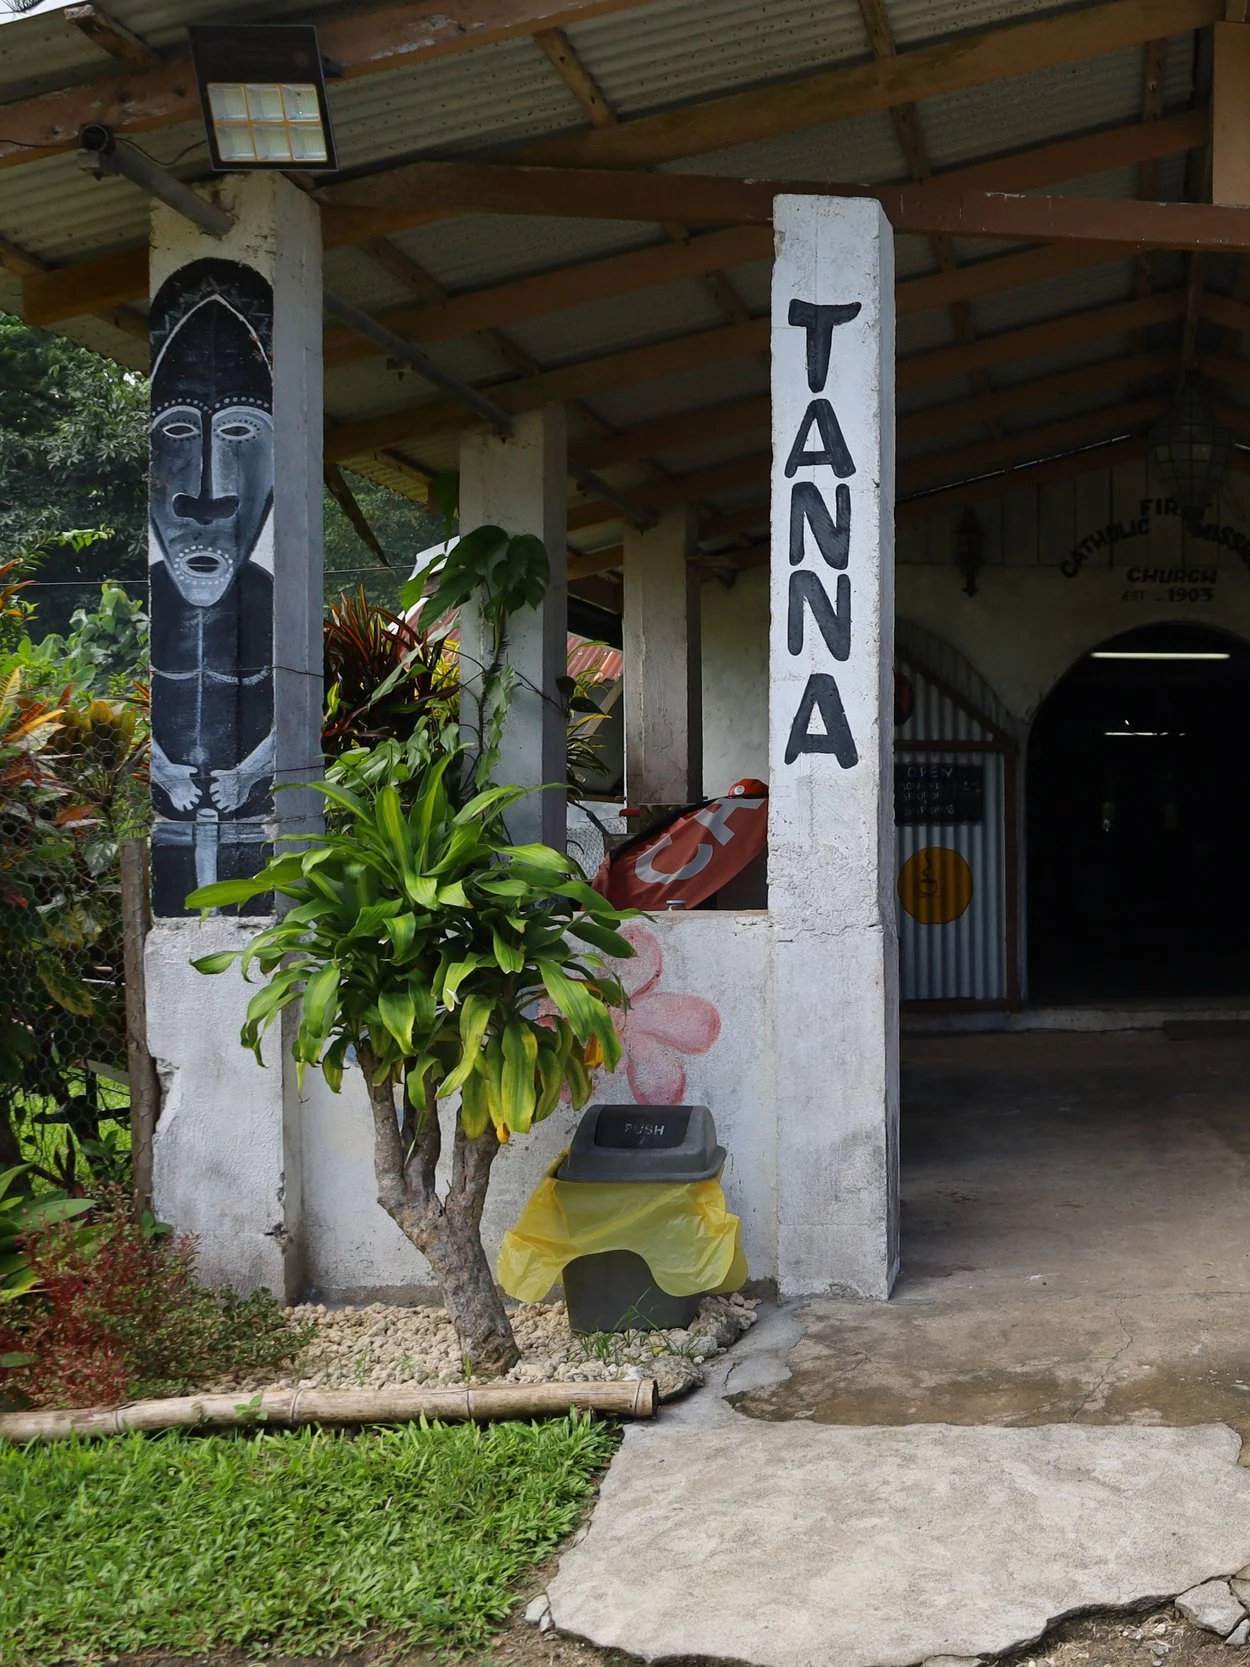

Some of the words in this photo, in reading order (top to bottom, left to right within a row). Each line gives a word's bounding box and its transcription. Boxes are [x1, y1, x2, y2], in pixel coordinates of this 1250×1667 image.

[785, 299, 861, 769] TANNA
[1060, 518, 1150, 579] CATHOLIC
[1126, 568, 1218, 584] CHURCH
[624, 1123, 665, 1137] PUSH
